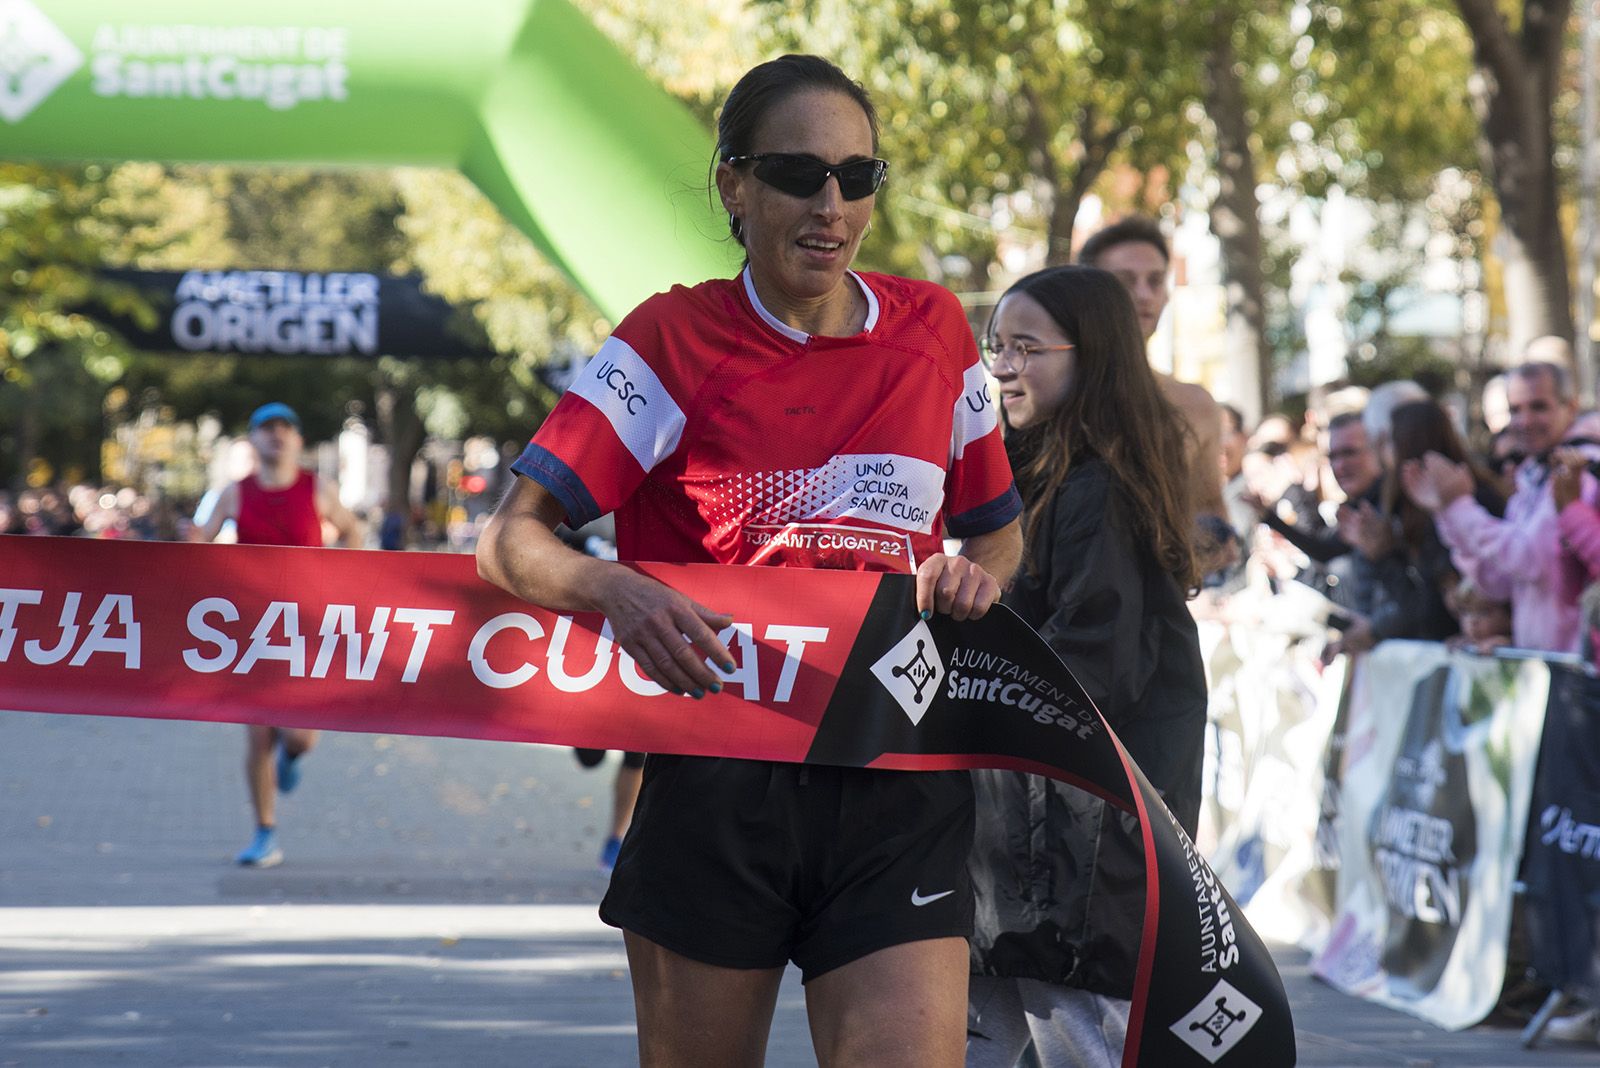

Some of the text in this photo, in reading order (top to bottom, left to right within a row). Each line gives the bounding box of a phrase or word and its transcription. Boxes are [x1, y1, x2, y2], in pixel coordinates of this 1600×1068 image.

[91, 56, 349, 111] SantCugat
[171, 301, 380, 354] ORIGEN
[596, 360, 647, 416] UCSC
[783, 405, 816, 417] TACTIC
[853, 480, 909, 500] CICLISTA
[856, 459, 894, 477] UNIÓ
[849, 497, 929, 525] SANT CUGAT
[770, 533, 815, 549] SANT
[817, 534, 878, 552] CUGAT
[880, 541, 901, 556] 22
[0, 588, 142, 670] TJA
[182, 597, 456, 683] SANT
[947, 670, 1094, 740] SantCugat
[949, 647, 1103, 732] AJUNTAMENT DE
[1176, 830, 1217, 973] AJUNTAMENT
[1193, 844, 1240, 969] SantC
